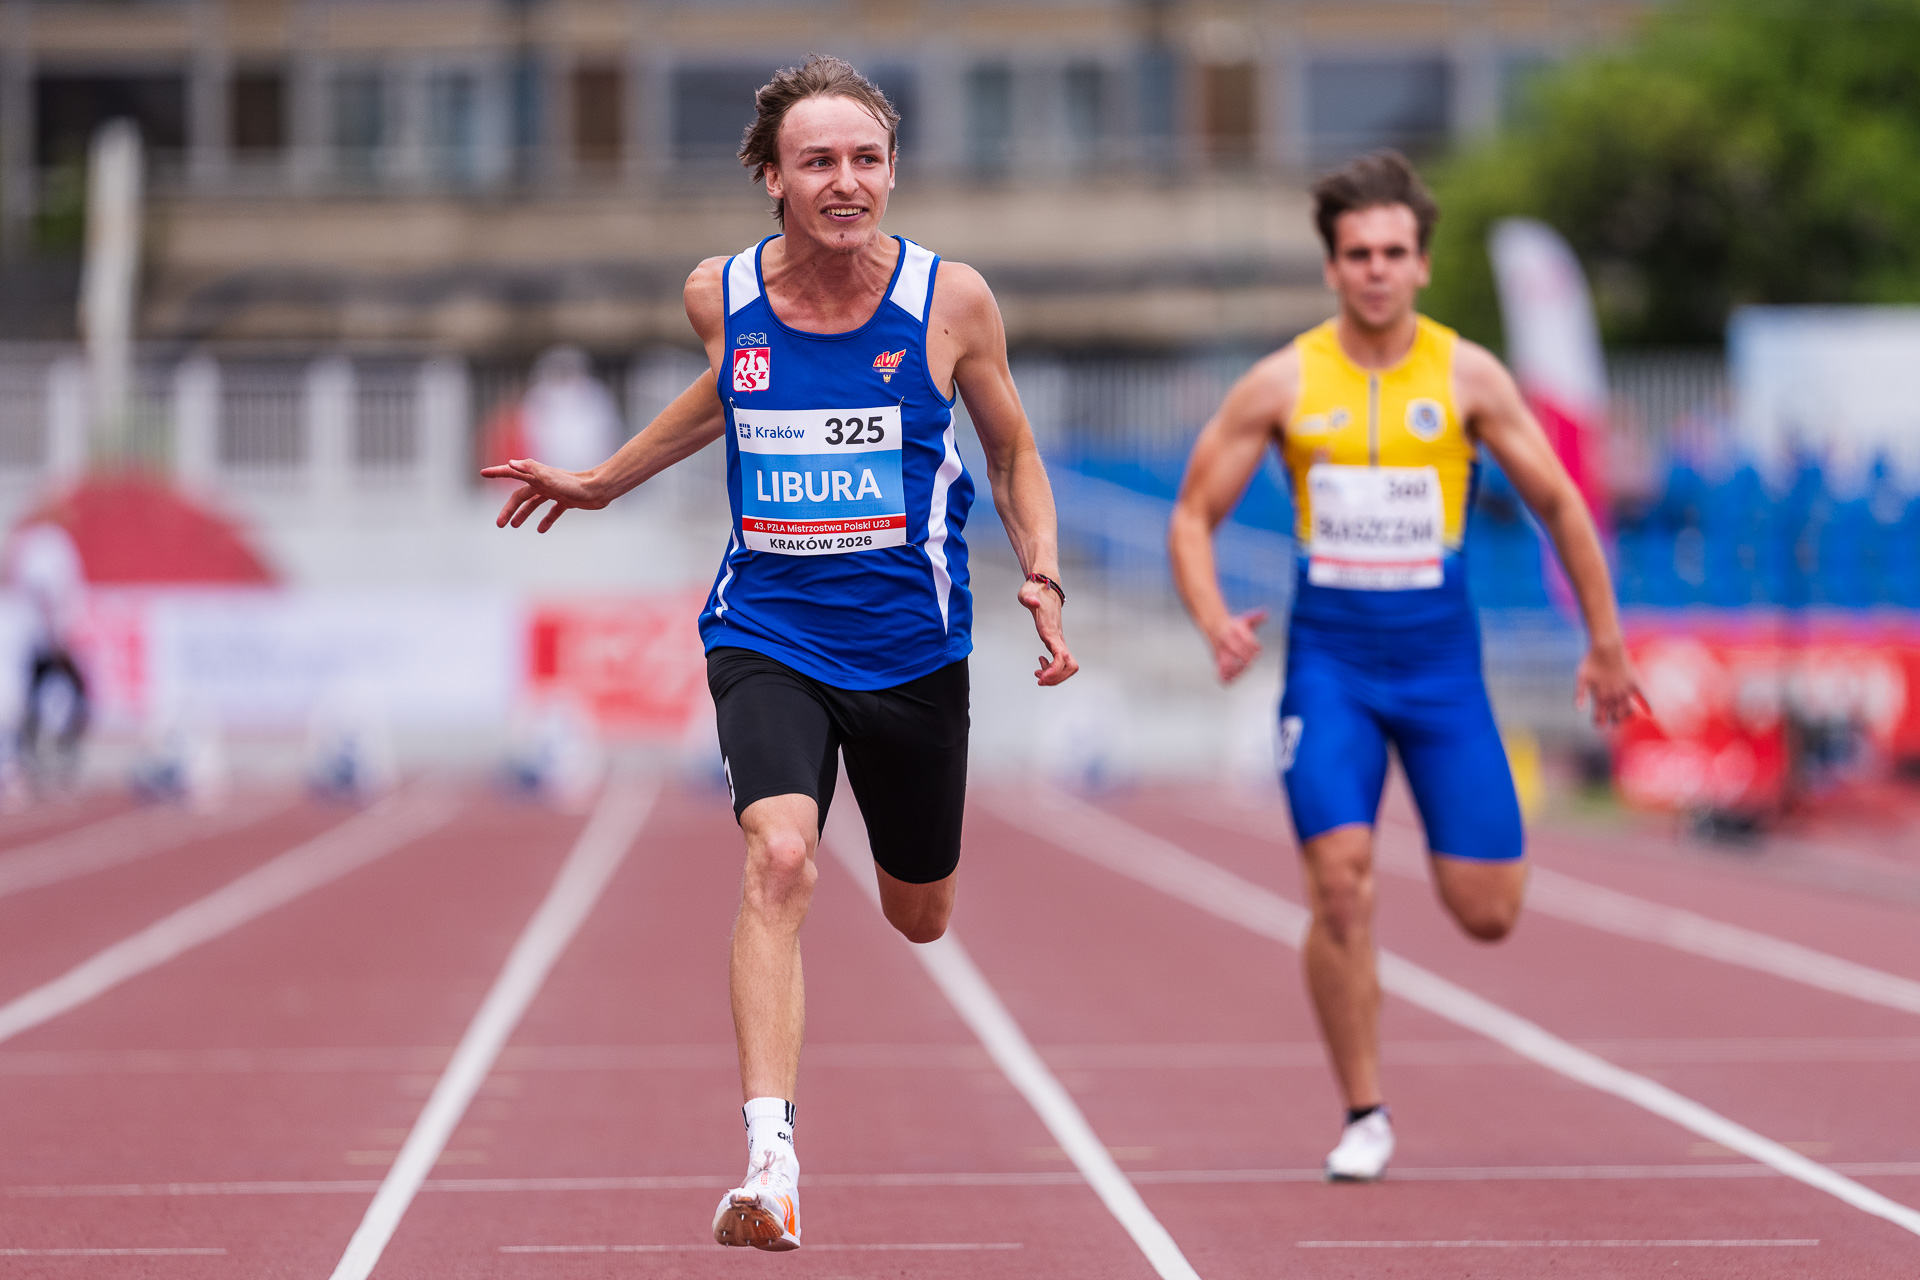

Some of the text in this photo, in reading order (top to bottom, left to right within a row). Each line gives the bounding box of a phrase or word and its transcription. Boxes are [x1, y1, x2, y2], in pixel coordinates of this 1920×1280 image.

[873, 349, 906, 367] AWF
[755, 426, 805, 439] Kraków
[825, 416, 885, 445] 325
[757, 468, 883, 503] LIBURA
[754, 519, 891, 533] 43. PZLA Mistrzostwa Polski U23
[769, 535, 873, 551] KRAKÓW 2026
